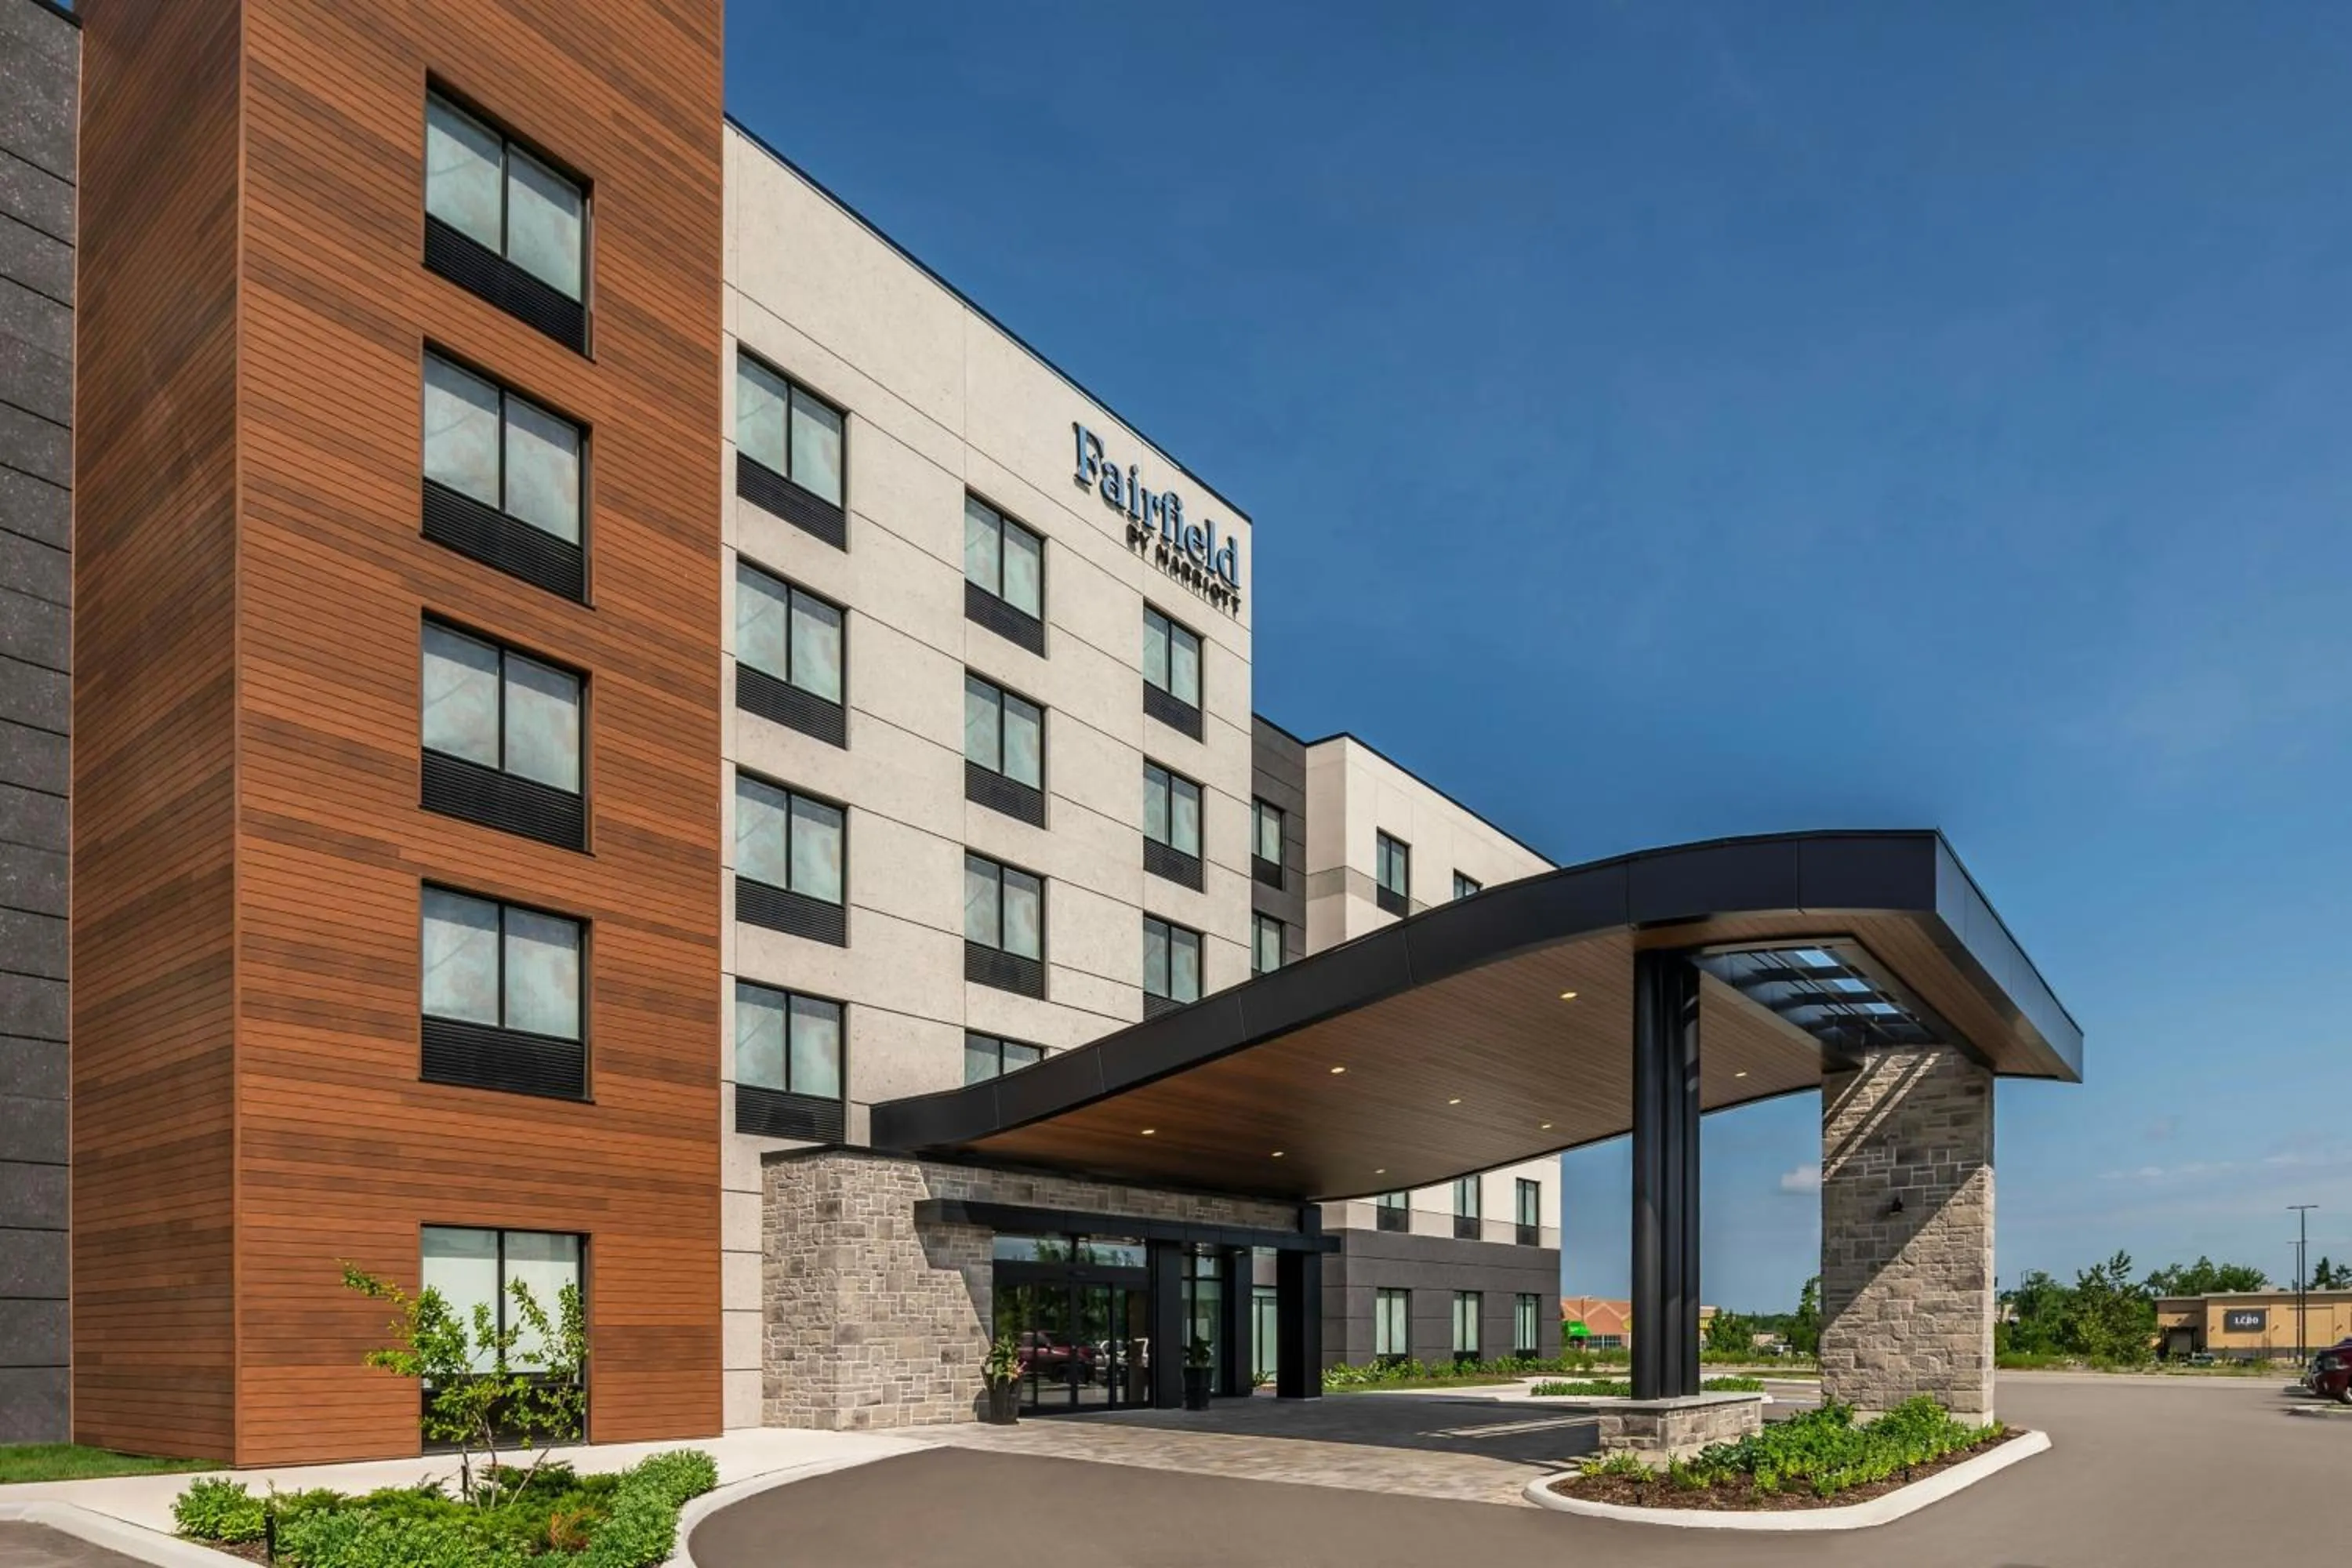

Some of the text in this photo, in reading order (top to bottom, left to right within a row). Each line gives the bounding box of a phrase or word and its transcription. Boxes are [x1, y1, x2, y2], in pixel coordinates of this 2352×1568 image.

[1073, 422, 1240, 590] Fairfield
[1126, 524, 1241, 613] BY MARRIOTT
[2234, 1316, 2259, 1324] LCBO
